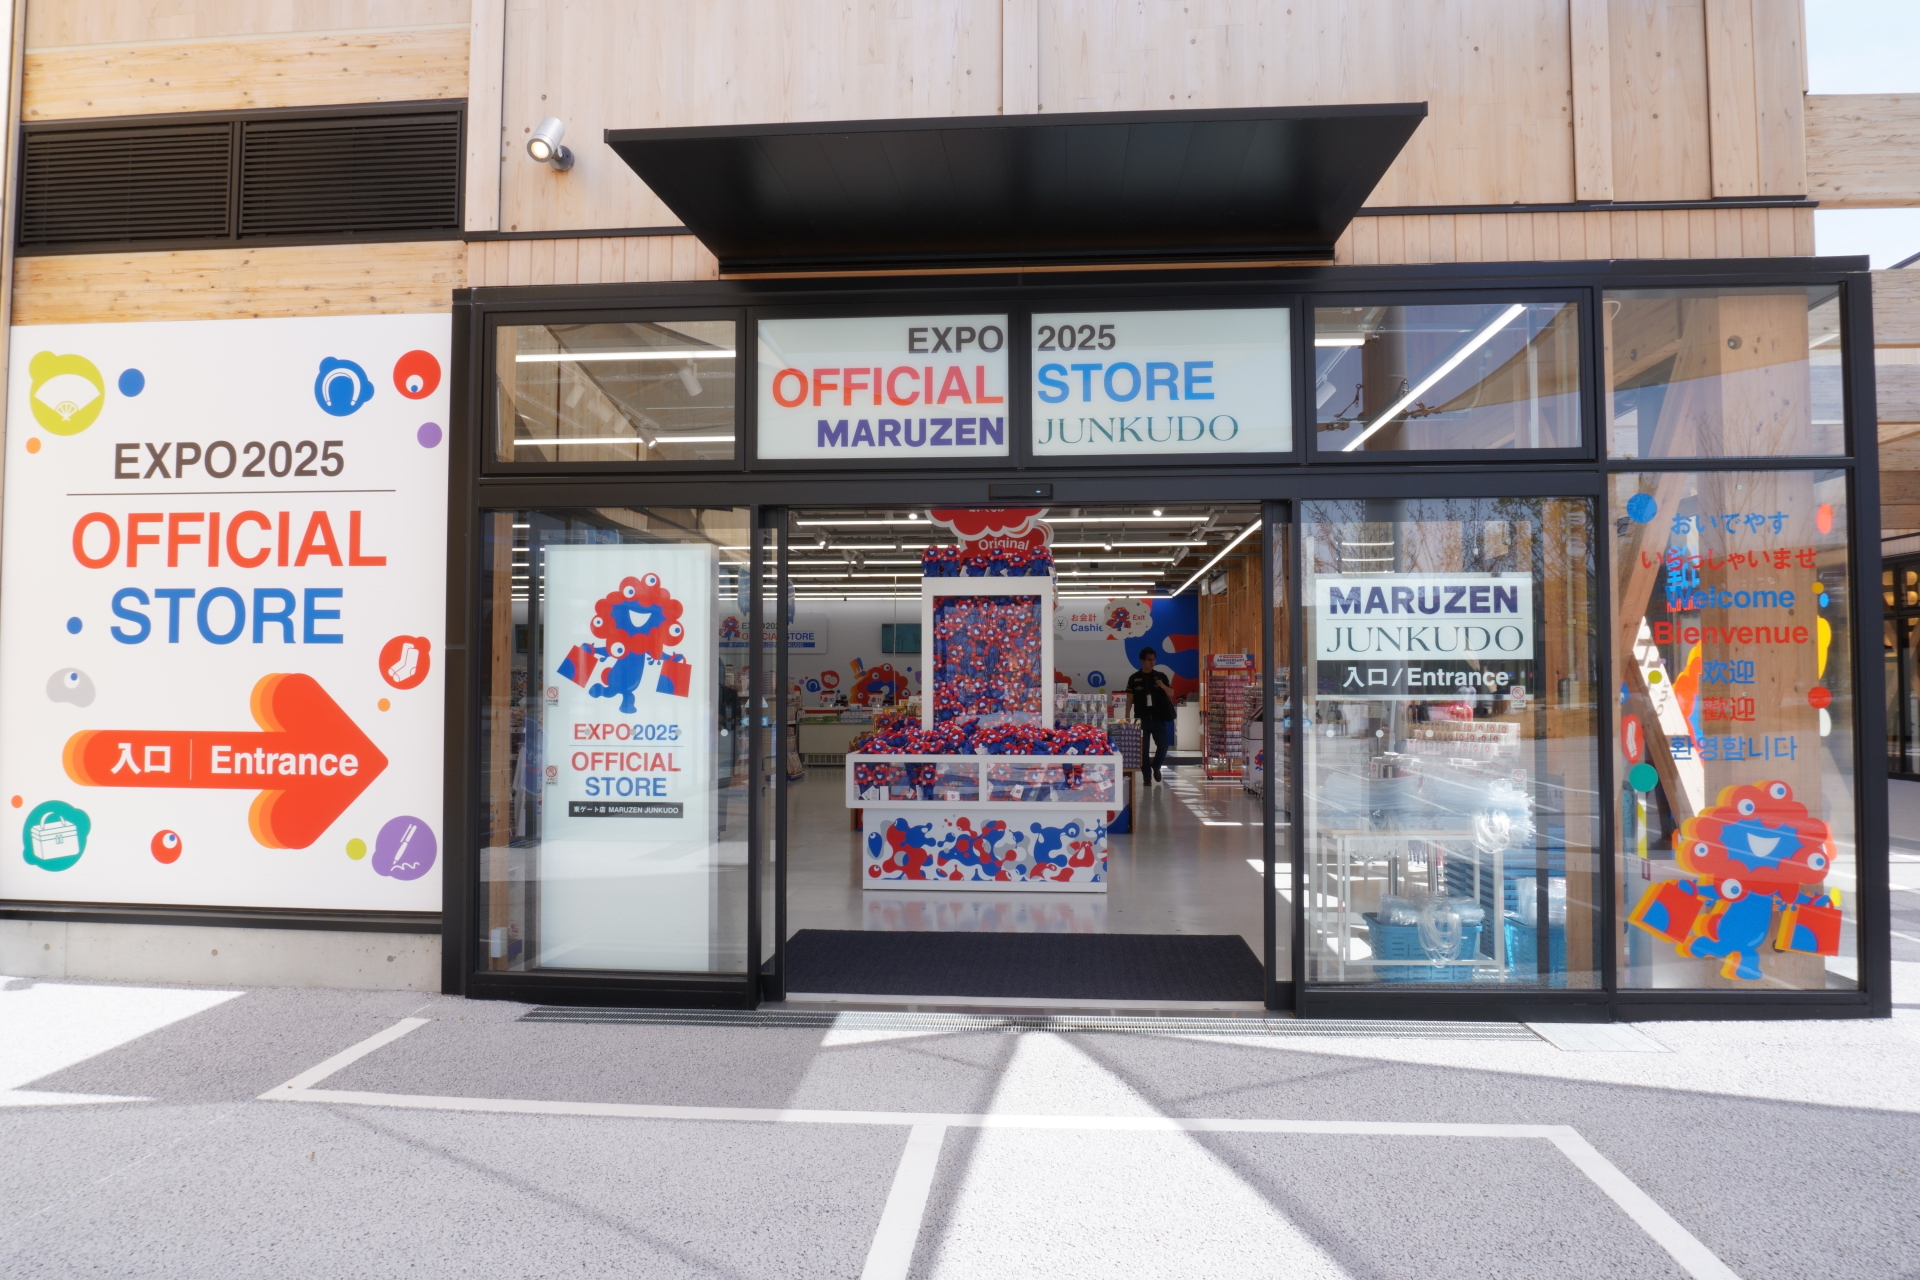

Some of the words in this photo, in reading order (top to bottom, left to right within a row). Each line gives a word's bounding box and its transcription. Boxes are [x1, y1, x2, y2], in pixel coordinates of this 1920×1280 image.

[908, 326, 1003, 354] EXPO
[1037, 324, 1116, 352] 2025
[772, 365, 1004, 408] OFFICIAL
[1037, 360, 1215, 403] STORE
[816, 417, 1004, 448] MARUZEN
[1037, 414, 1239, 445] JUNKUDO
[1671, 511, 1789, 535] おいでやす
[71, 510, 387, 569] OFFICIAL
[1641, 548, 1817, 570] いらっしゃいませ
[1329, 585, 1519, 615] MARUZEN
[1665, 586, 1796, 609] Welcome
[110, 586, 344, 645] STORE
[1070, 613, 1097, 622] お会計
[1070, 623, 1104, 632] Cashie
[1326, 625, 1525, 653] JUNKUDO
[1653, 621, 1809, 645] Bienvenue
[1702, 659, 1756, 684] 欢迎
[573, 723, 680, 741] EXPO2025
[110, 742, 171, 775] 入口
[1670, 735, 1798, 761] 환영합니다
[210, 745, 359, 777] Entrance
[571, 751, 682, 772] OFFICIAL
[585, 776, 667, 797] STORE
[608, 806, 643, 814] MARUZEN
[644, 806, 679, 815] JUNKUDO
